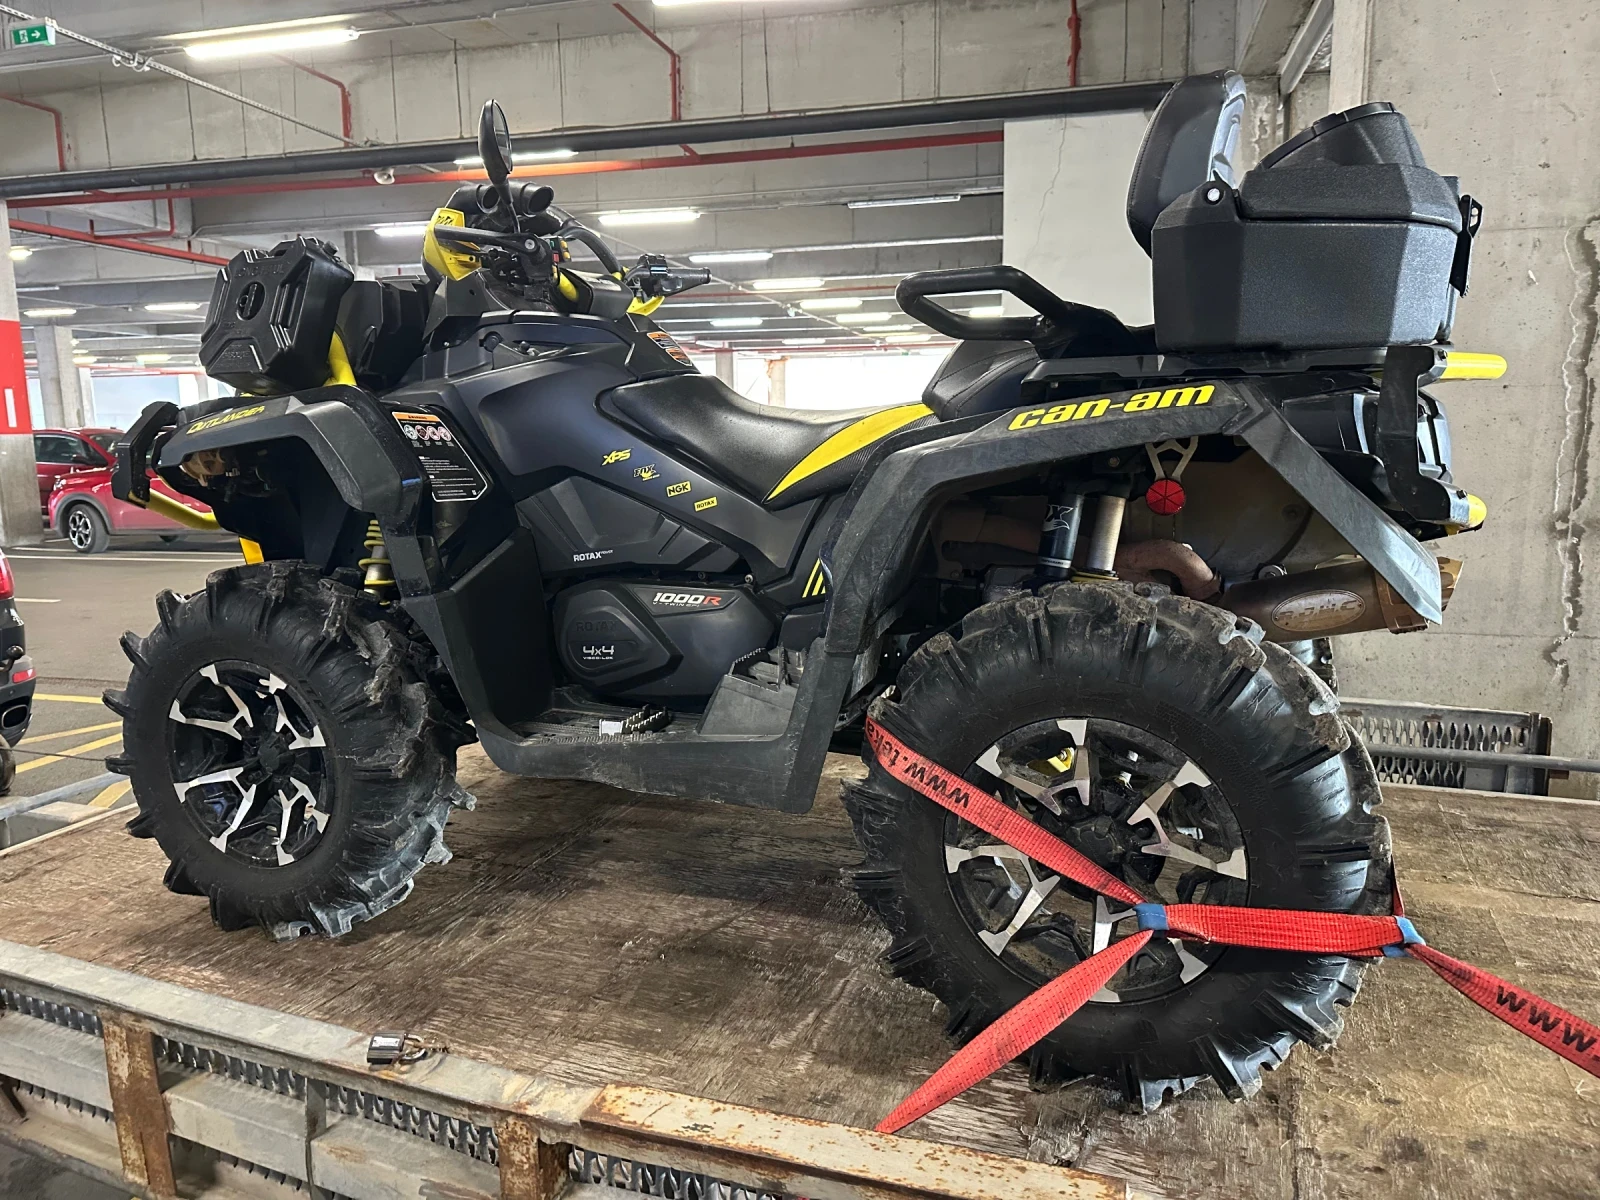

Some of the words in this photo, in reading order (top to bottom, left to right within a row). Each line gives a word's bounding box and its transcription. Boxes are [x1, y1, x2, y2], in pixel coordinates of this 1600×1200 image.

[1008, 385, 1215, 431] can-am
[186, 405, 265, 434] OUTLANDER
[602, 449, 632, 466] XPS
[668, 483, 690, 496] NGK
[696, 500, 716, 510] ROTAX
[573, 551, 602, 562] ROTAX
[653, 592, 722, 606] 1000R
[582, 645, 615, 656] 4x4
